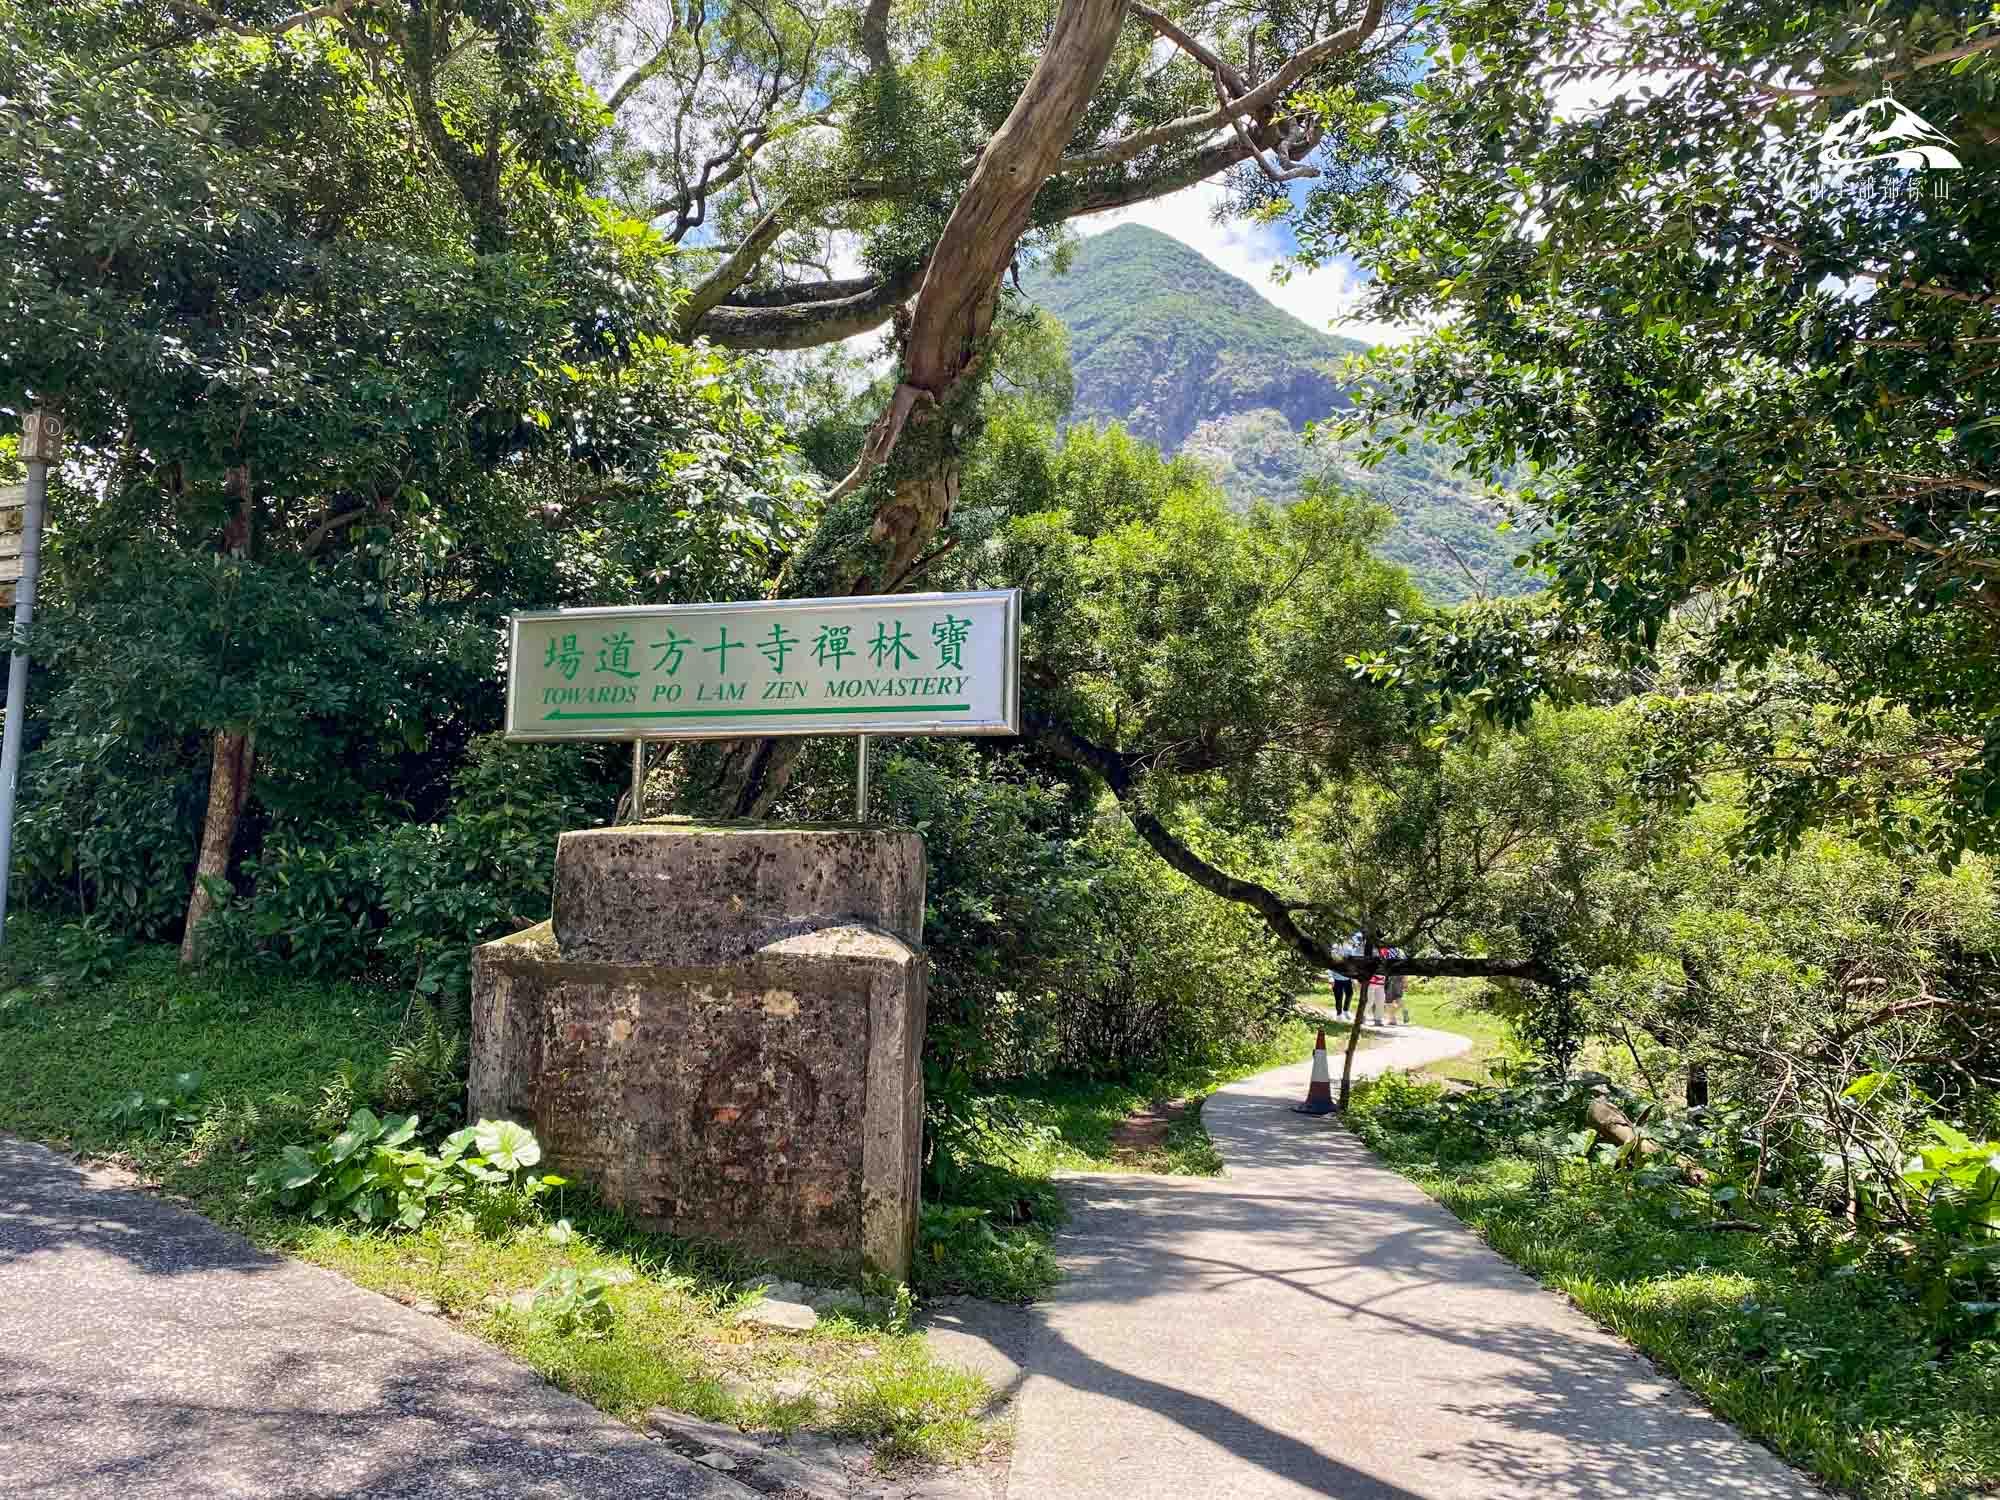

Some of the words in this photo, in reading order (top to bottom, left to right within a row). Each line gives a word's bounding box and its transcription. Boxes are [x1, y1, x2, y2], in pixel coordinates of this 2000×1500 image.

[543, 687, 638, 704] TOWARDS
[652, 684, 682, 703] PO
[696, 682, 747, 701] LAM
[761, 680, 808, 700] ZEN
[824, 676, 970, 699] MONASTERY
